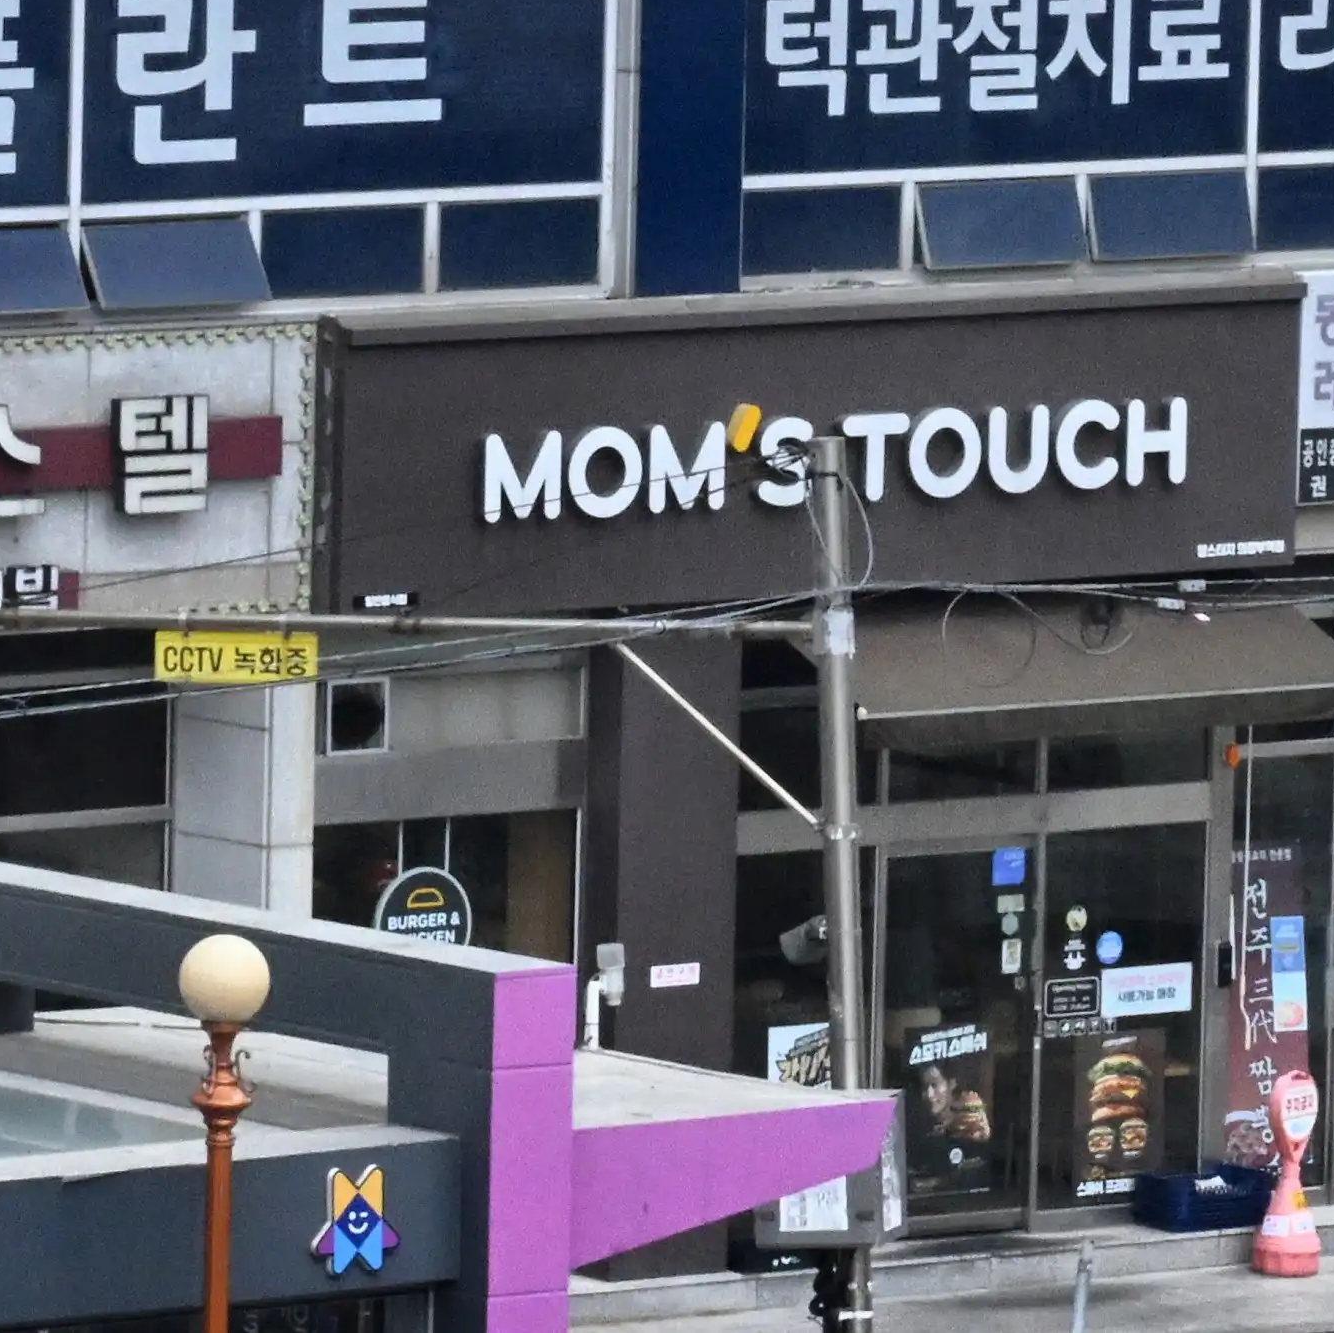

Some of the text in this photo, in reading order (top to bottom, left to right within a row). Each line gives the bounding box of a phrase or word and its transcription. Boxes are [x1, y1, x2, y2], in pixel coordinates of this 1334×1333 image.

[483, 396, 1189, 525] MOM'S TOUCH
[162, 644, 309, 679] CCTV 녹화중
[387, 910, 461, 931] BURGER &
